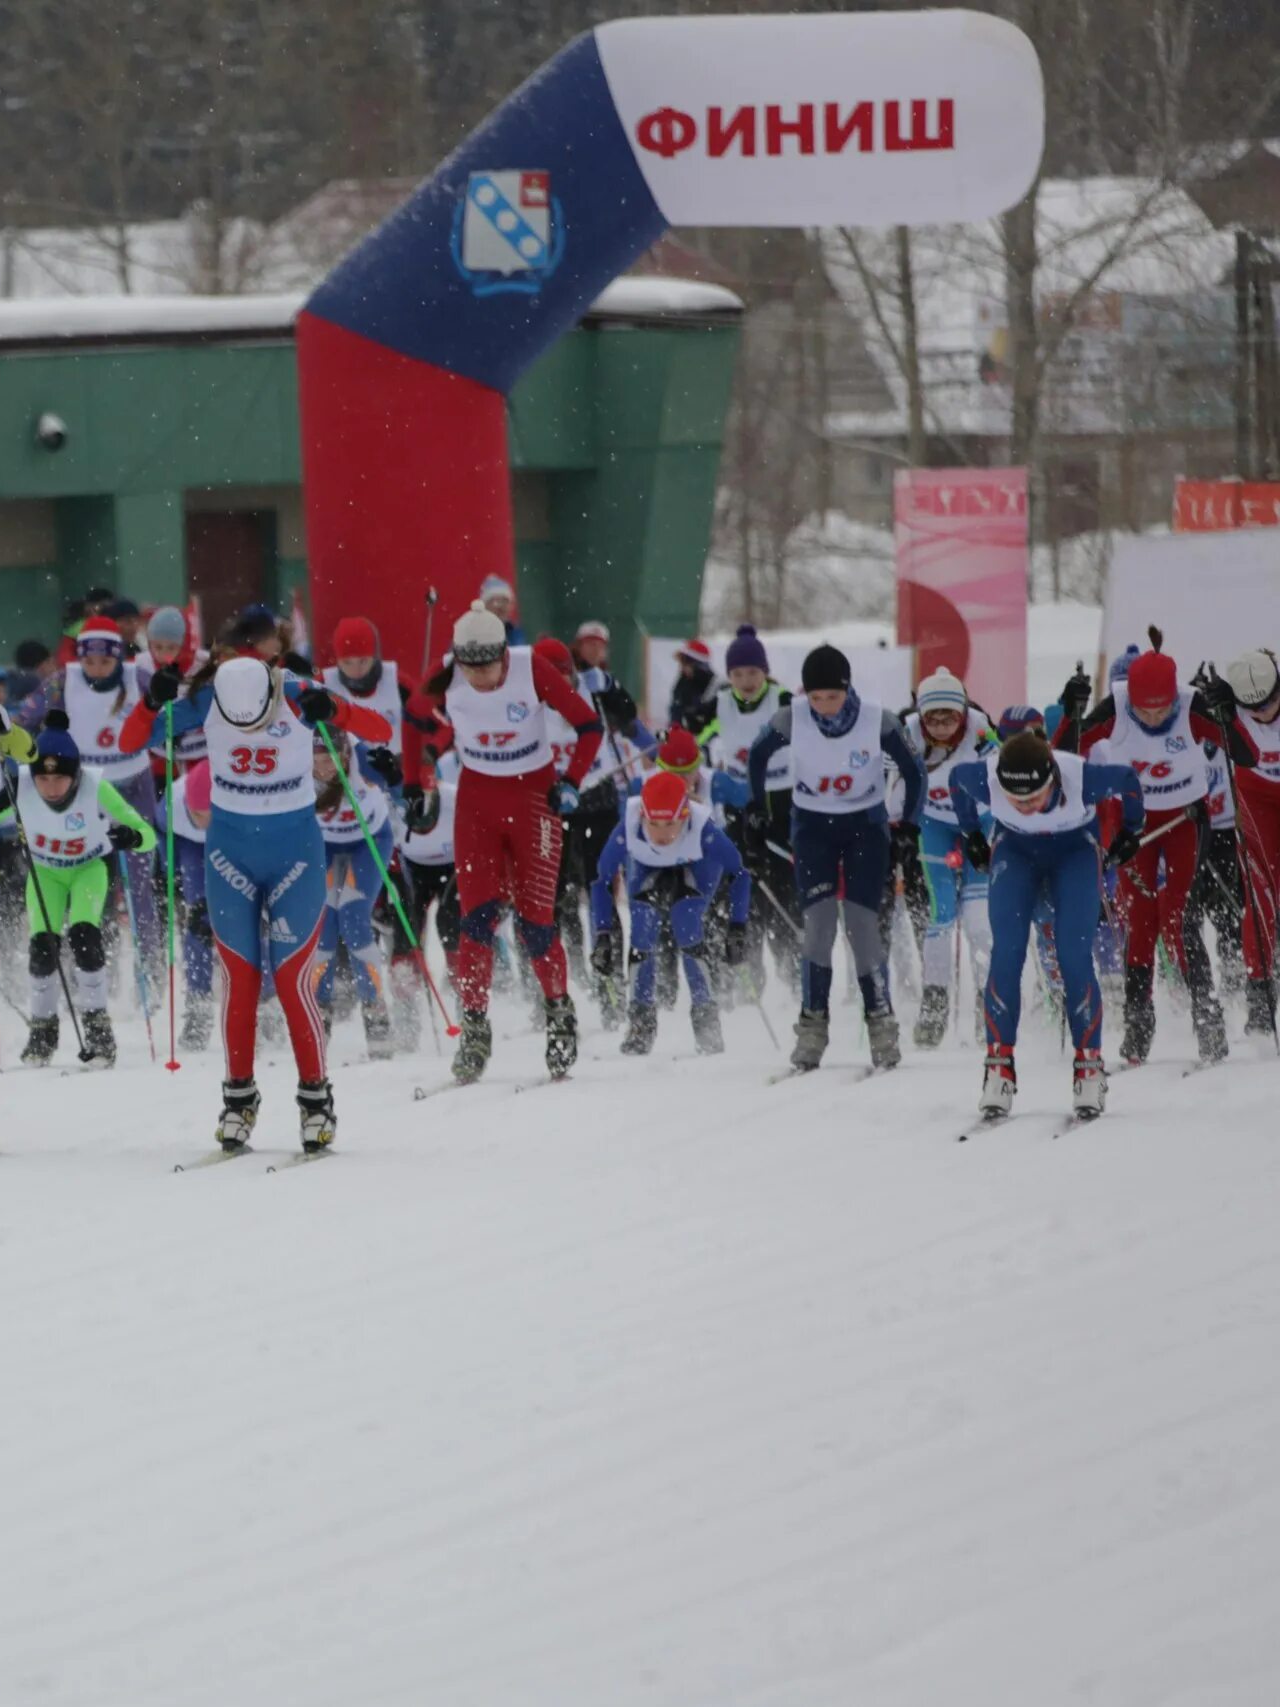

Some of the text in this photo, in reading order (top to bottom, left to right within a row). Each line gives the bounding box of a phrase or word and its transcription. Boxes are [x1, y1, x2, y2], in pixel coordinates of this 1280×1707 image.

[635, 98, 955, 158] ФИНИШ
[230, 745, 279, 776] 35
[35, 833, 87, 855] 115
[209, 849, 257, 902] LUKOIL
